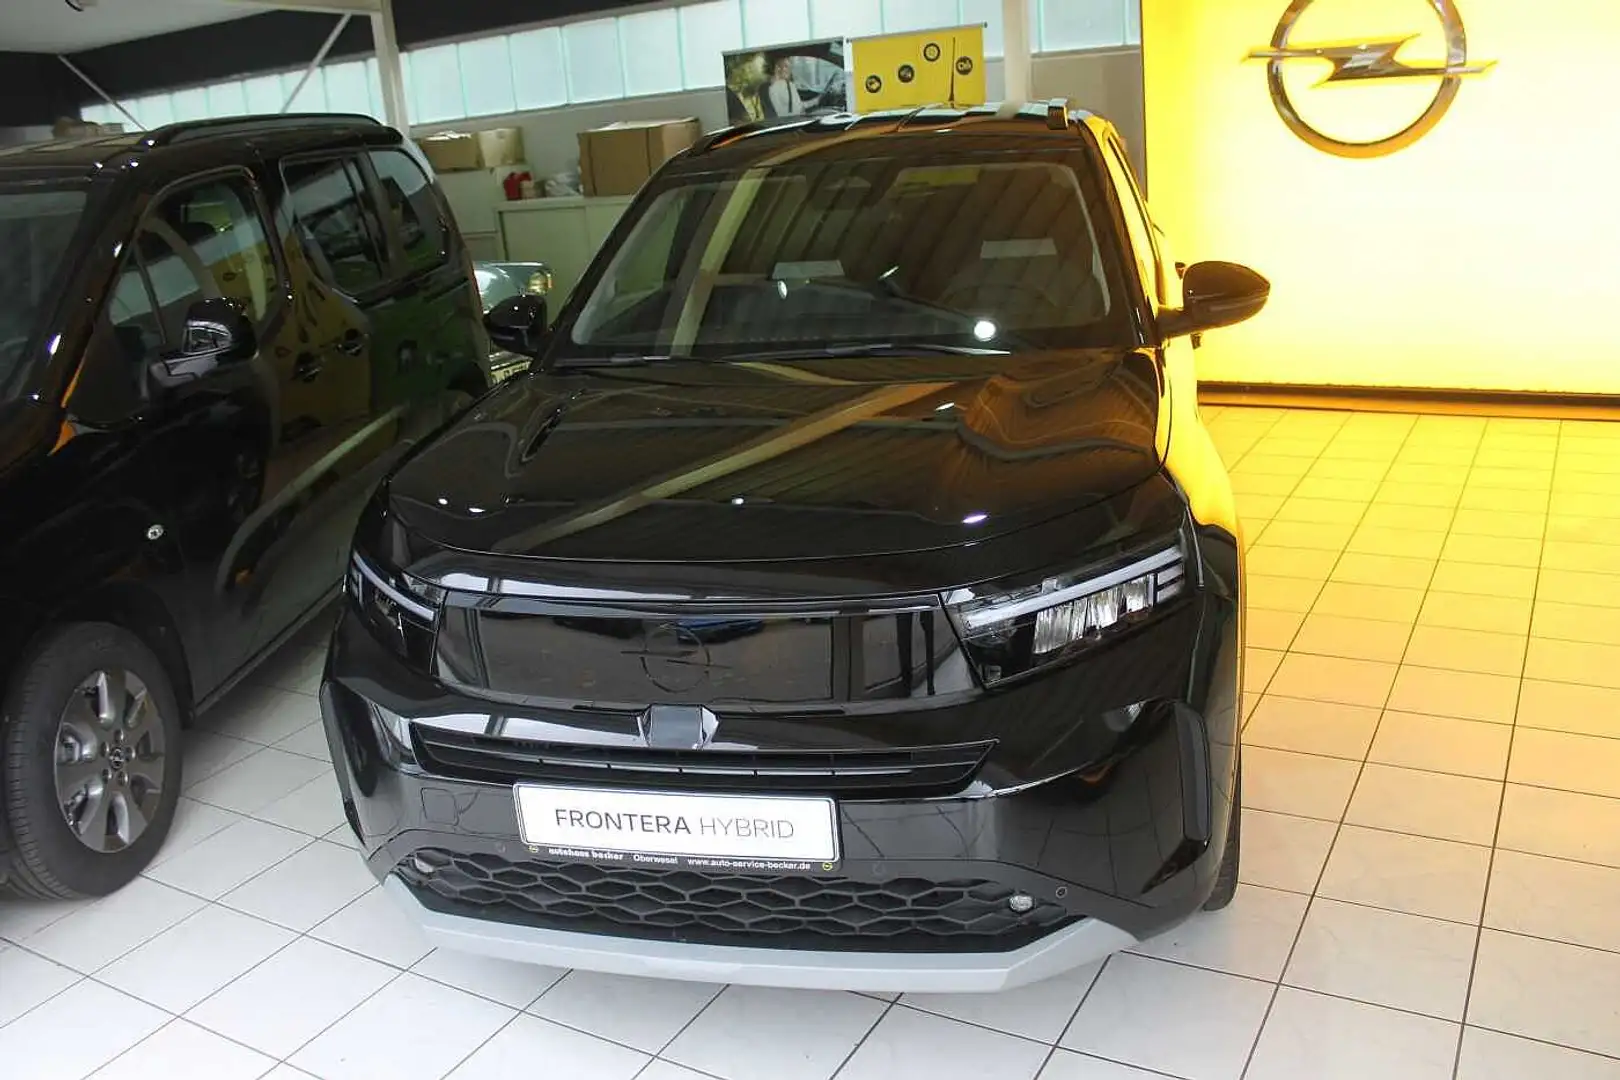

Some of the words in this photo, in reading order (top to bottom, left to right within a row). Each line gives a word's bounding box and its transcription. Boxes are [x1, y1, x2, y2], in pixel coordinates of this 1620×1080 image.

[555, 808, 691, 834] FRONTERA
[699, 816, 794, 838] HYBRID
[549, 848, 590, 858] autohaus
[633, 854, 678, 864] Oberwesel
[687, 858, 811, 870] www.auto-service-becker.de
